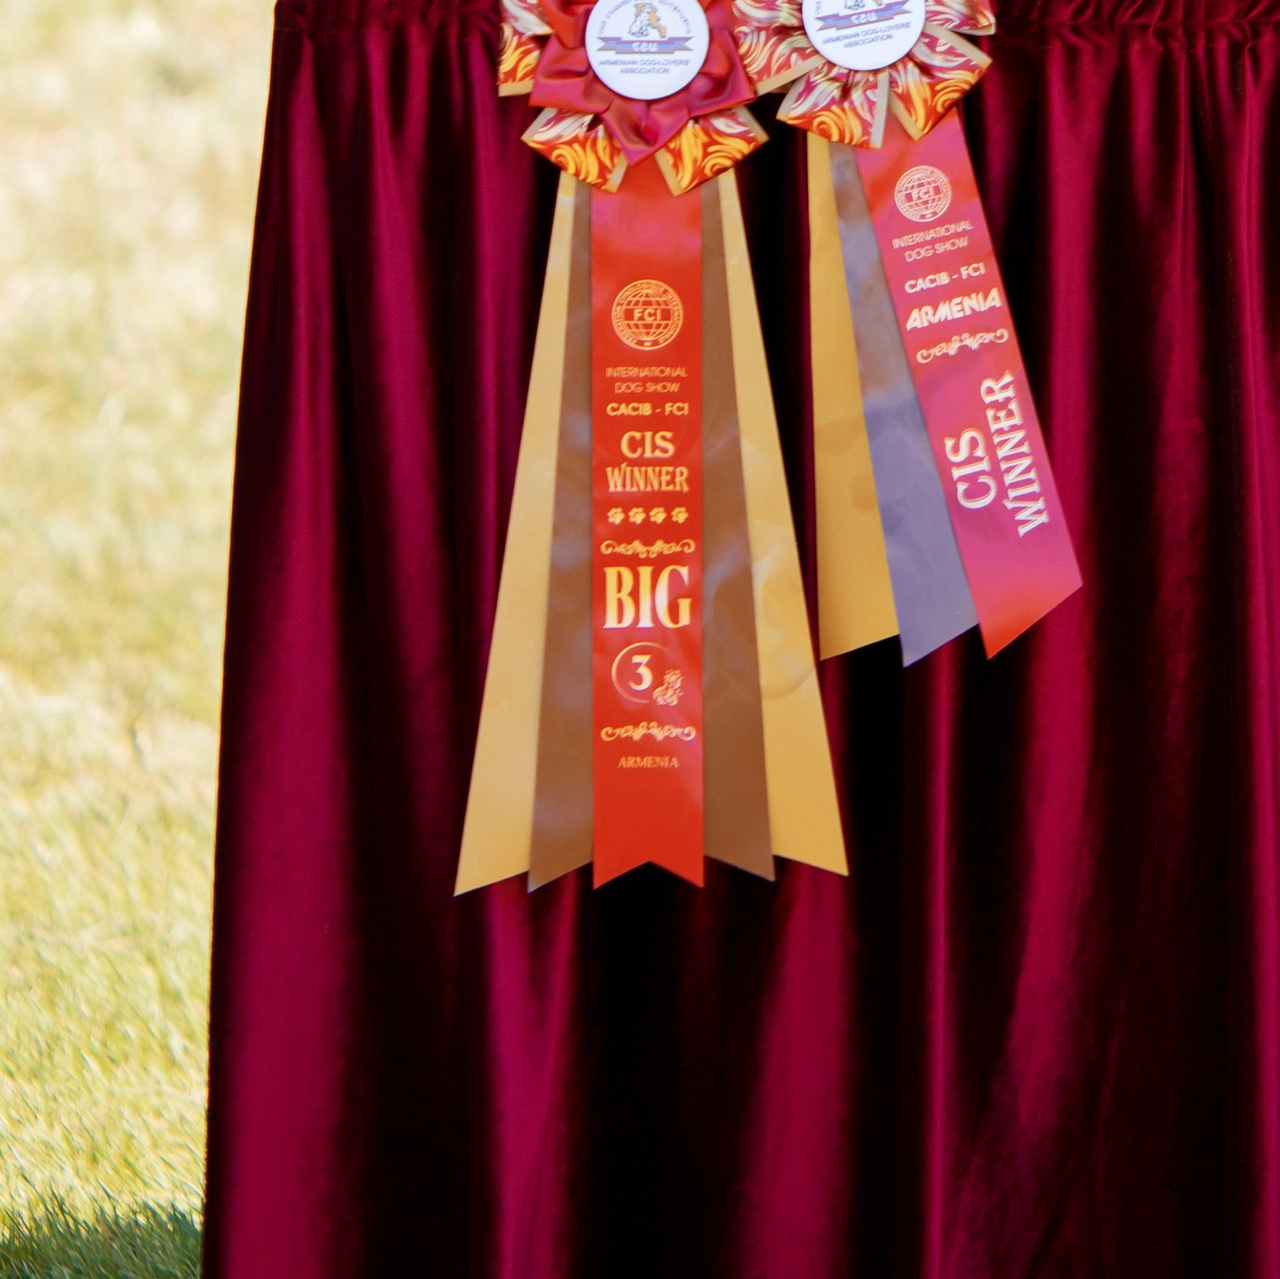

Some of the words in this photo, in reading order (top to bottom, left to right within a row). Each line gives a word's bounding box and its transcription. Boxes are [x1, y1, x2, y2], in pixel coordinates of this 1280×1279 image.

[911, 187, 935, 202] FCI
[892, 219, 974, 249] INTERNATIONAL
[904, 245, 934, 262] DOG
[935, 236, 969, 254] SHOW
[904, 271, 950, 293] CACIB
[960, 262, 986, 280] FCI
[633, 308, 663, 321] FCI
[906, 287, 1002, 331] ARMENIA
[605, 366, 688, 378] INTERNATIONAL
[614, 382, 643, 394] DOG
[645, 381, 681, 394] SHOW
[606, 402, 653, 416] CACIB
[665, 402, 690, 416] FCI
[620, 430, 675, 459] CIS
[980, 369, 1049, 538] WINNER
[605, 462, 690, 493] WINNER
[943, 427, 998, 509] CIS
[603, 564, 692, 629] BIG
[628, 654, 653, 691] 3
[618, 755, 679, 769] ARMENIA
